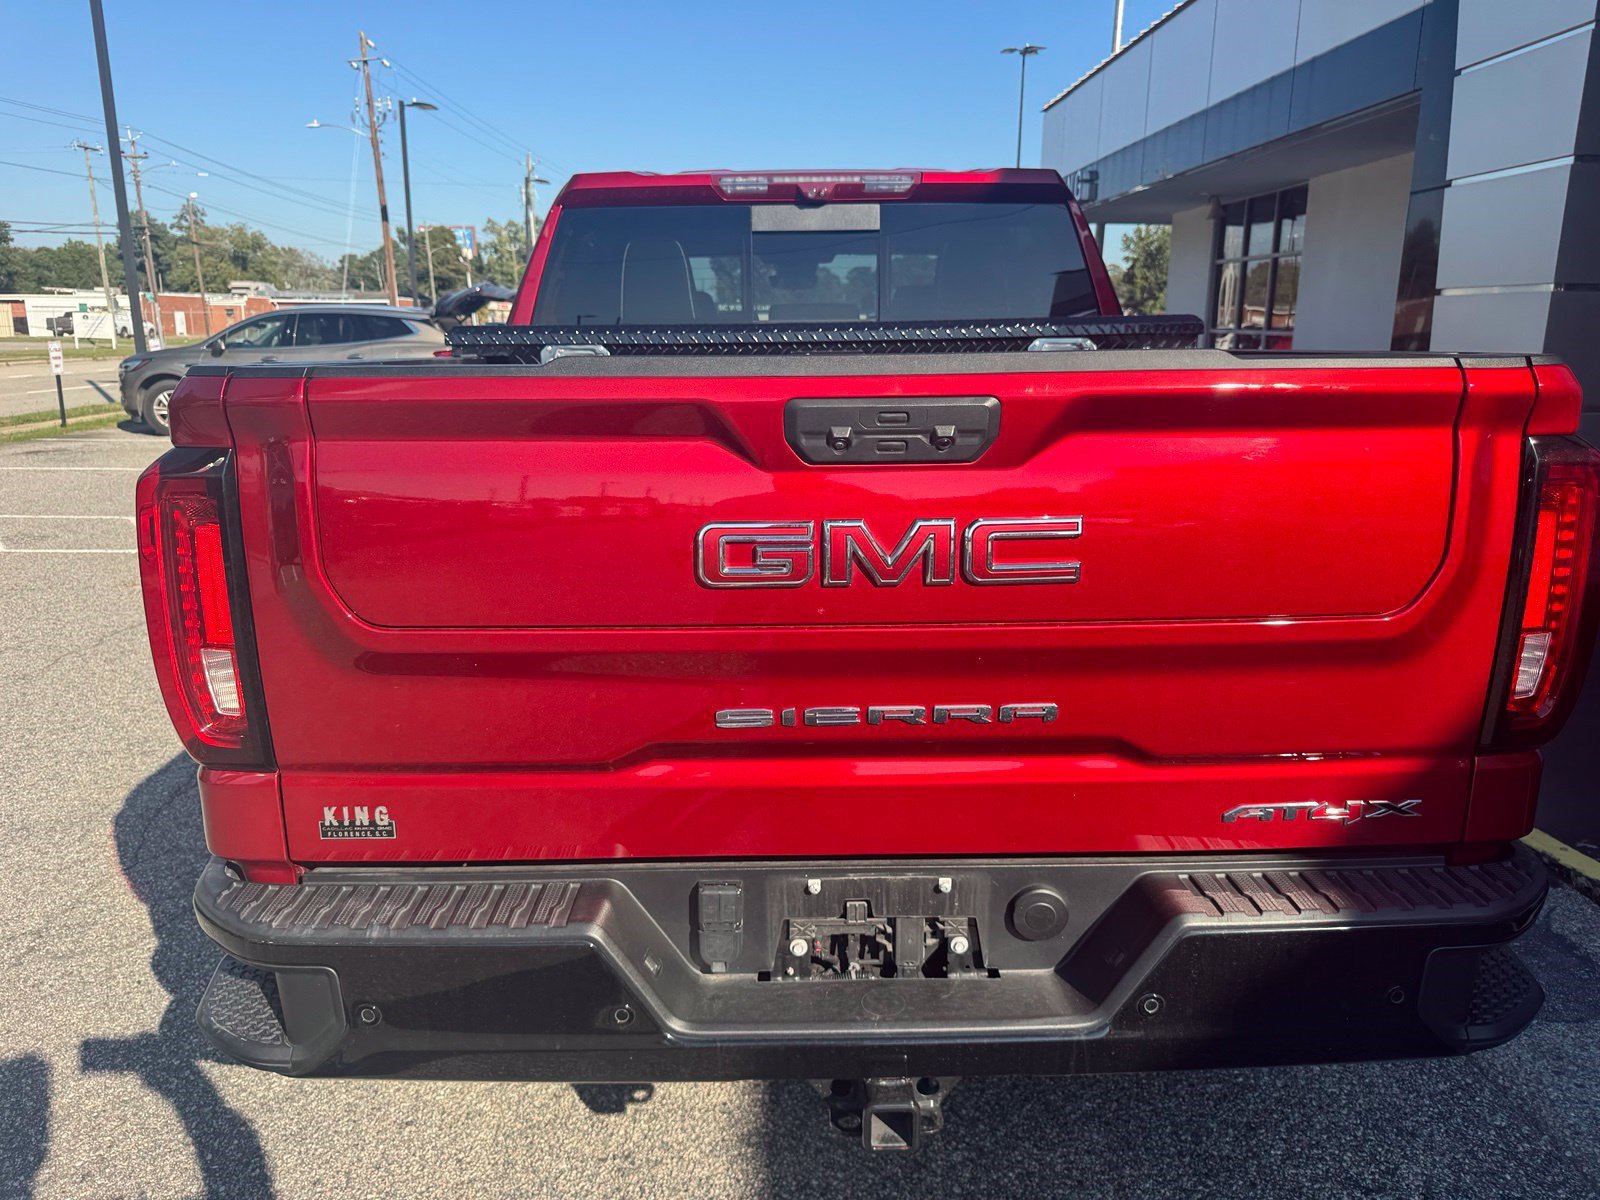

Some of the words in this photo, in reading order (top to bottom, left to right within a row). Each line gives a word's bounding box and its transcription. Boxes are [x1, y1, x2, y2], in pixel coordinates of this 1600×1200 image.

[694, 514, 1083, 589] GMC
[715, 703, 1059, 728] SIERRA
[323, 805, 390, 826] KING
[1221, 799, 1423, 826] AT4X
